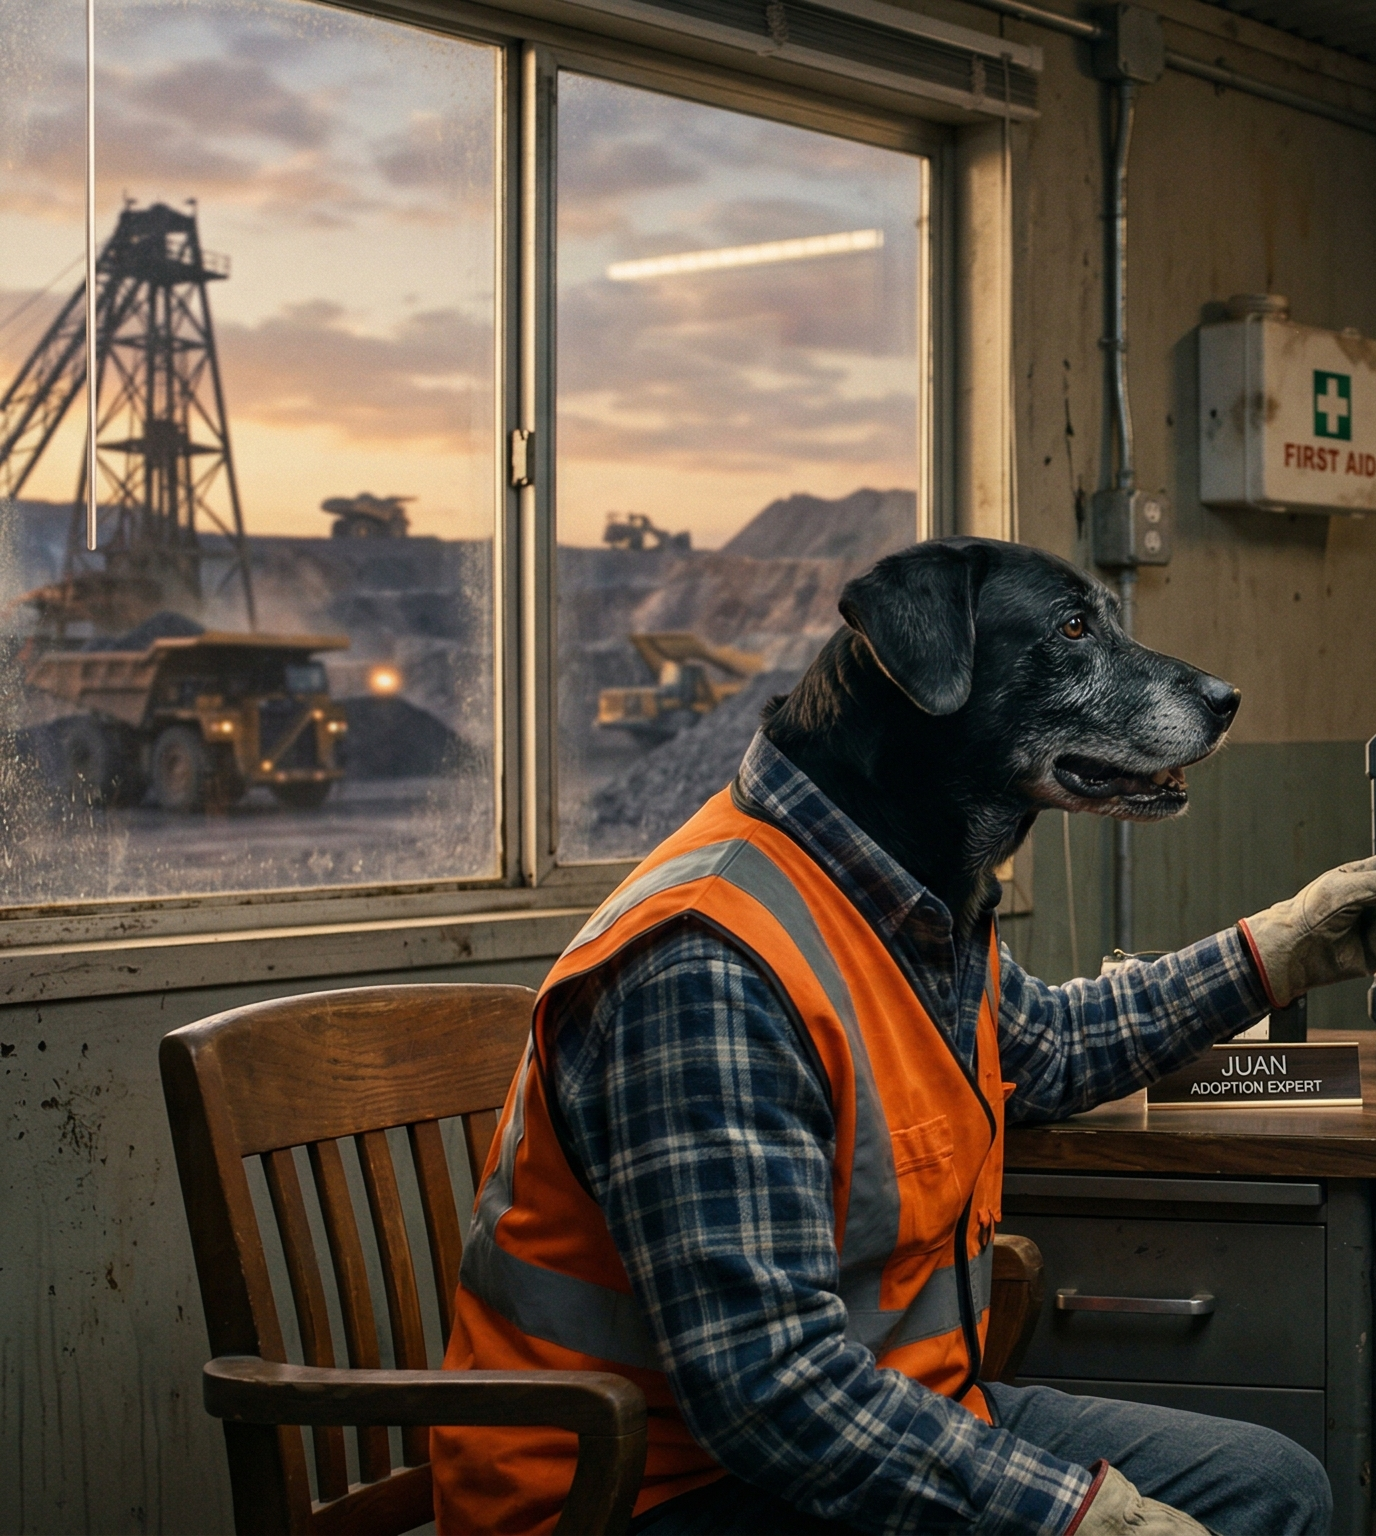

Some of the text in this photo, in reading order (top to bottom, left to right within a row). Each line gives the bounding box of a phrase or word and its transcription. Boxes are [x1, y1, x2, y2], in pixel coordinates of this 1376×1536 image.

[1284, 442, 1340, 473] FIRST
[1221, 1054, 1287, 1077] JUAN
[1190, 1079, 1323, 1095] ADOPTION EXPERT
